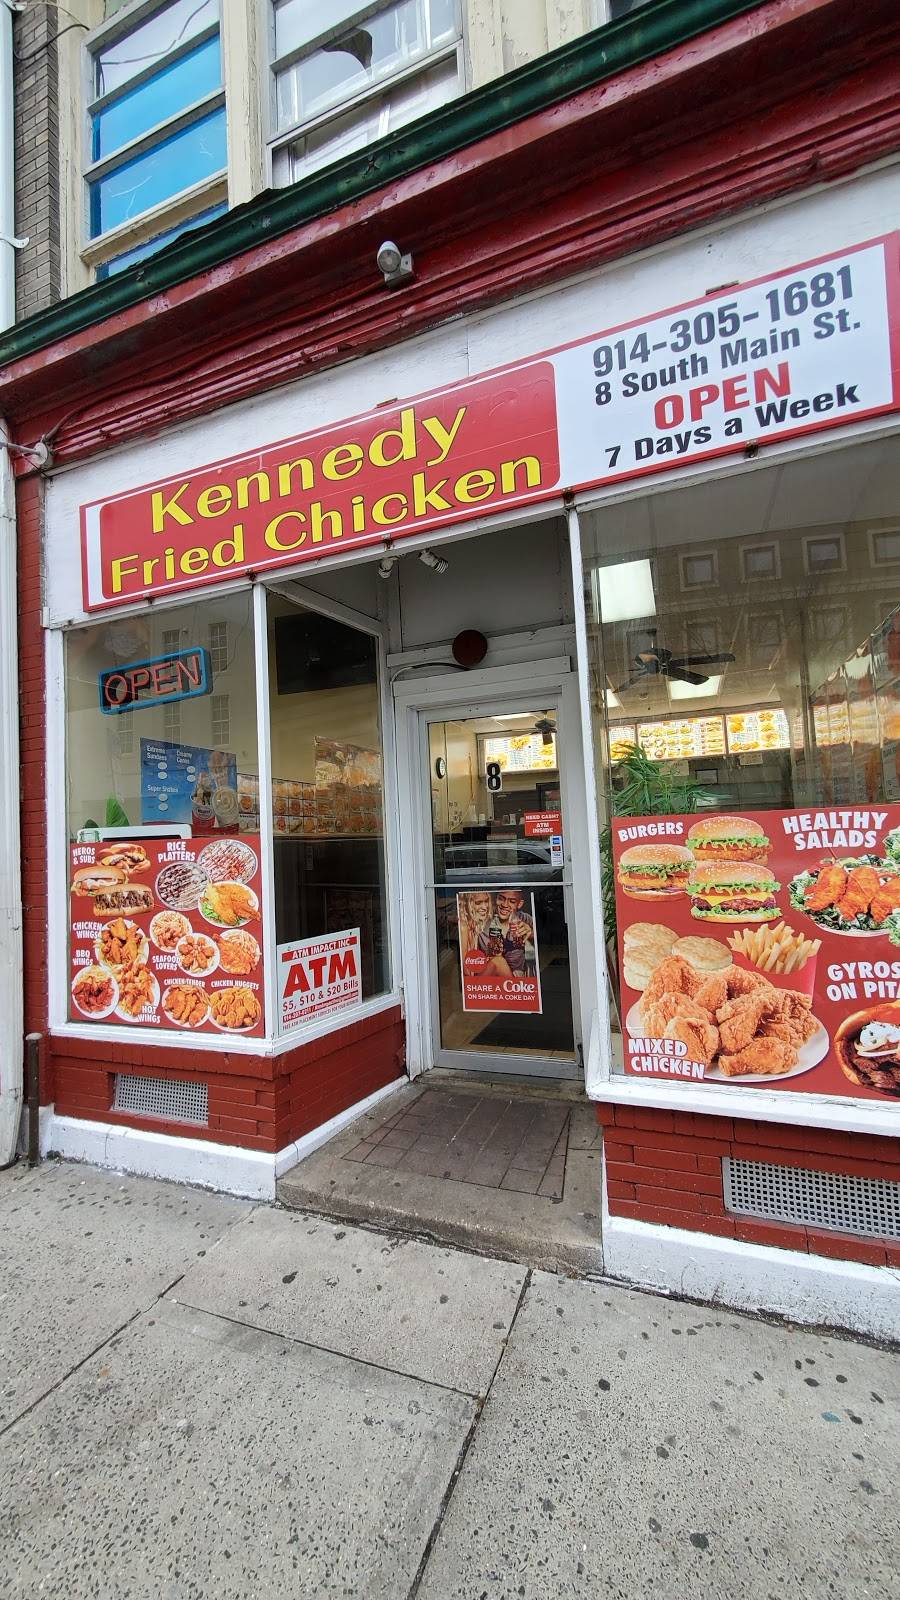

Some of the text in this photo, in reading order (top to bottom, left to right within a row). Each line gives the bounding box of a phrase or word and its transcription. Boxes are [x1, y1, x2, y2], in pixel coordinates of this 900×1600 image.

[593, 264, 853, 377] 914-305-1681
[595, 308, 861, 406] 8 South Main St.
[654, 361, 791, 430] OPEN
[604, 383, 861, 468] 7 Days a Week
[151, 407, 467, 534] Kennedy
[111, 455, 543, 593] Fried Chicken
[104, 655, 200, 705] OPEN
[487, 762, 501, 791] 8
[617, 822, 684, 842] BURGERS
[782, 811, 889, 834] HEALTHY
[166, 842, 186, 852] RICE
[794, 830, 877, 851] SALADS
[72, 847, 95, 857] HEROS
[73, 855, 95, 865] & SUBS
[158, 851, 195, 862] PLATTERS
[72, 921, 102, 930] CHICKEN
[76, 930, 98, 939] WINGS
[293, 939, 350, 959] ATM IMPACT INC
[72, 958, 93, 966] WINGS
[152, 955, 180, 963] SEAFOOD
[155, 962, 178, 971] LOVERS
[283, 950, 356, 998] ATM
[827, 961, 900, 981] GYROS
[164, 978, 205, 987] CHICKEN TENDER
[233, 981, 259, 990] NUGGETS
[503, 980, 535, 992] Coke
[826, 982, 857, 1001] ON
[283, 1000, 296, 1011] $5,
[300, 994, 315, 1005] $10
[318, 991, 324, 999] &
[327, 985, 341, 996] $20
[344, 980, 358, 990] Bills
[138, 1014, 160, 1023] WINGS
[142, 1005, 156, 1015] HOT
[628, 1038, 688, 1056] MIXED
[631, 1056, 705, 1079] CHICKEN
